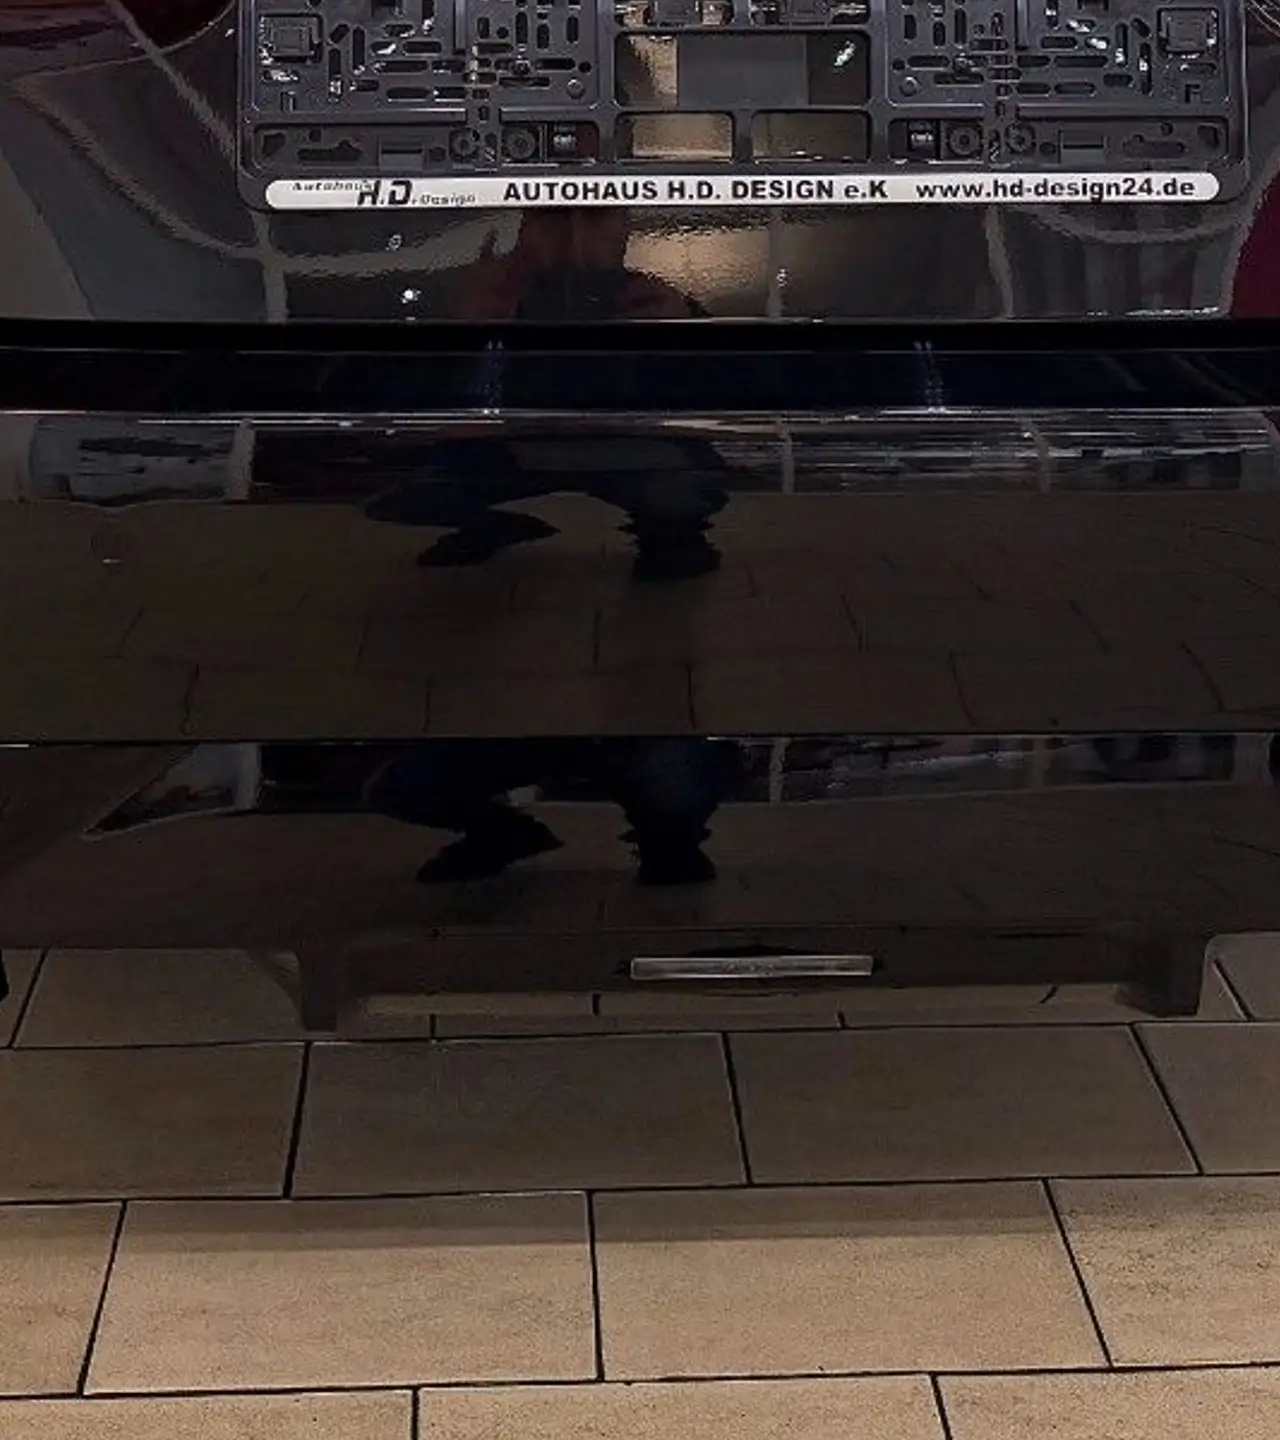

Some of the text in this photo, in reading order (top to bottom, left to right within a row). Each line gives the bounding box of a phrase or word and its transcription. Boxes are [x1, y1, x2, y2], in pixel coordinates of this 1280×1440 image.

[502, 179, 888, 201] AUTOHAUS H.D. DESIGN e.K
[916, 177, 1195, 201] www.hd-design24.de
